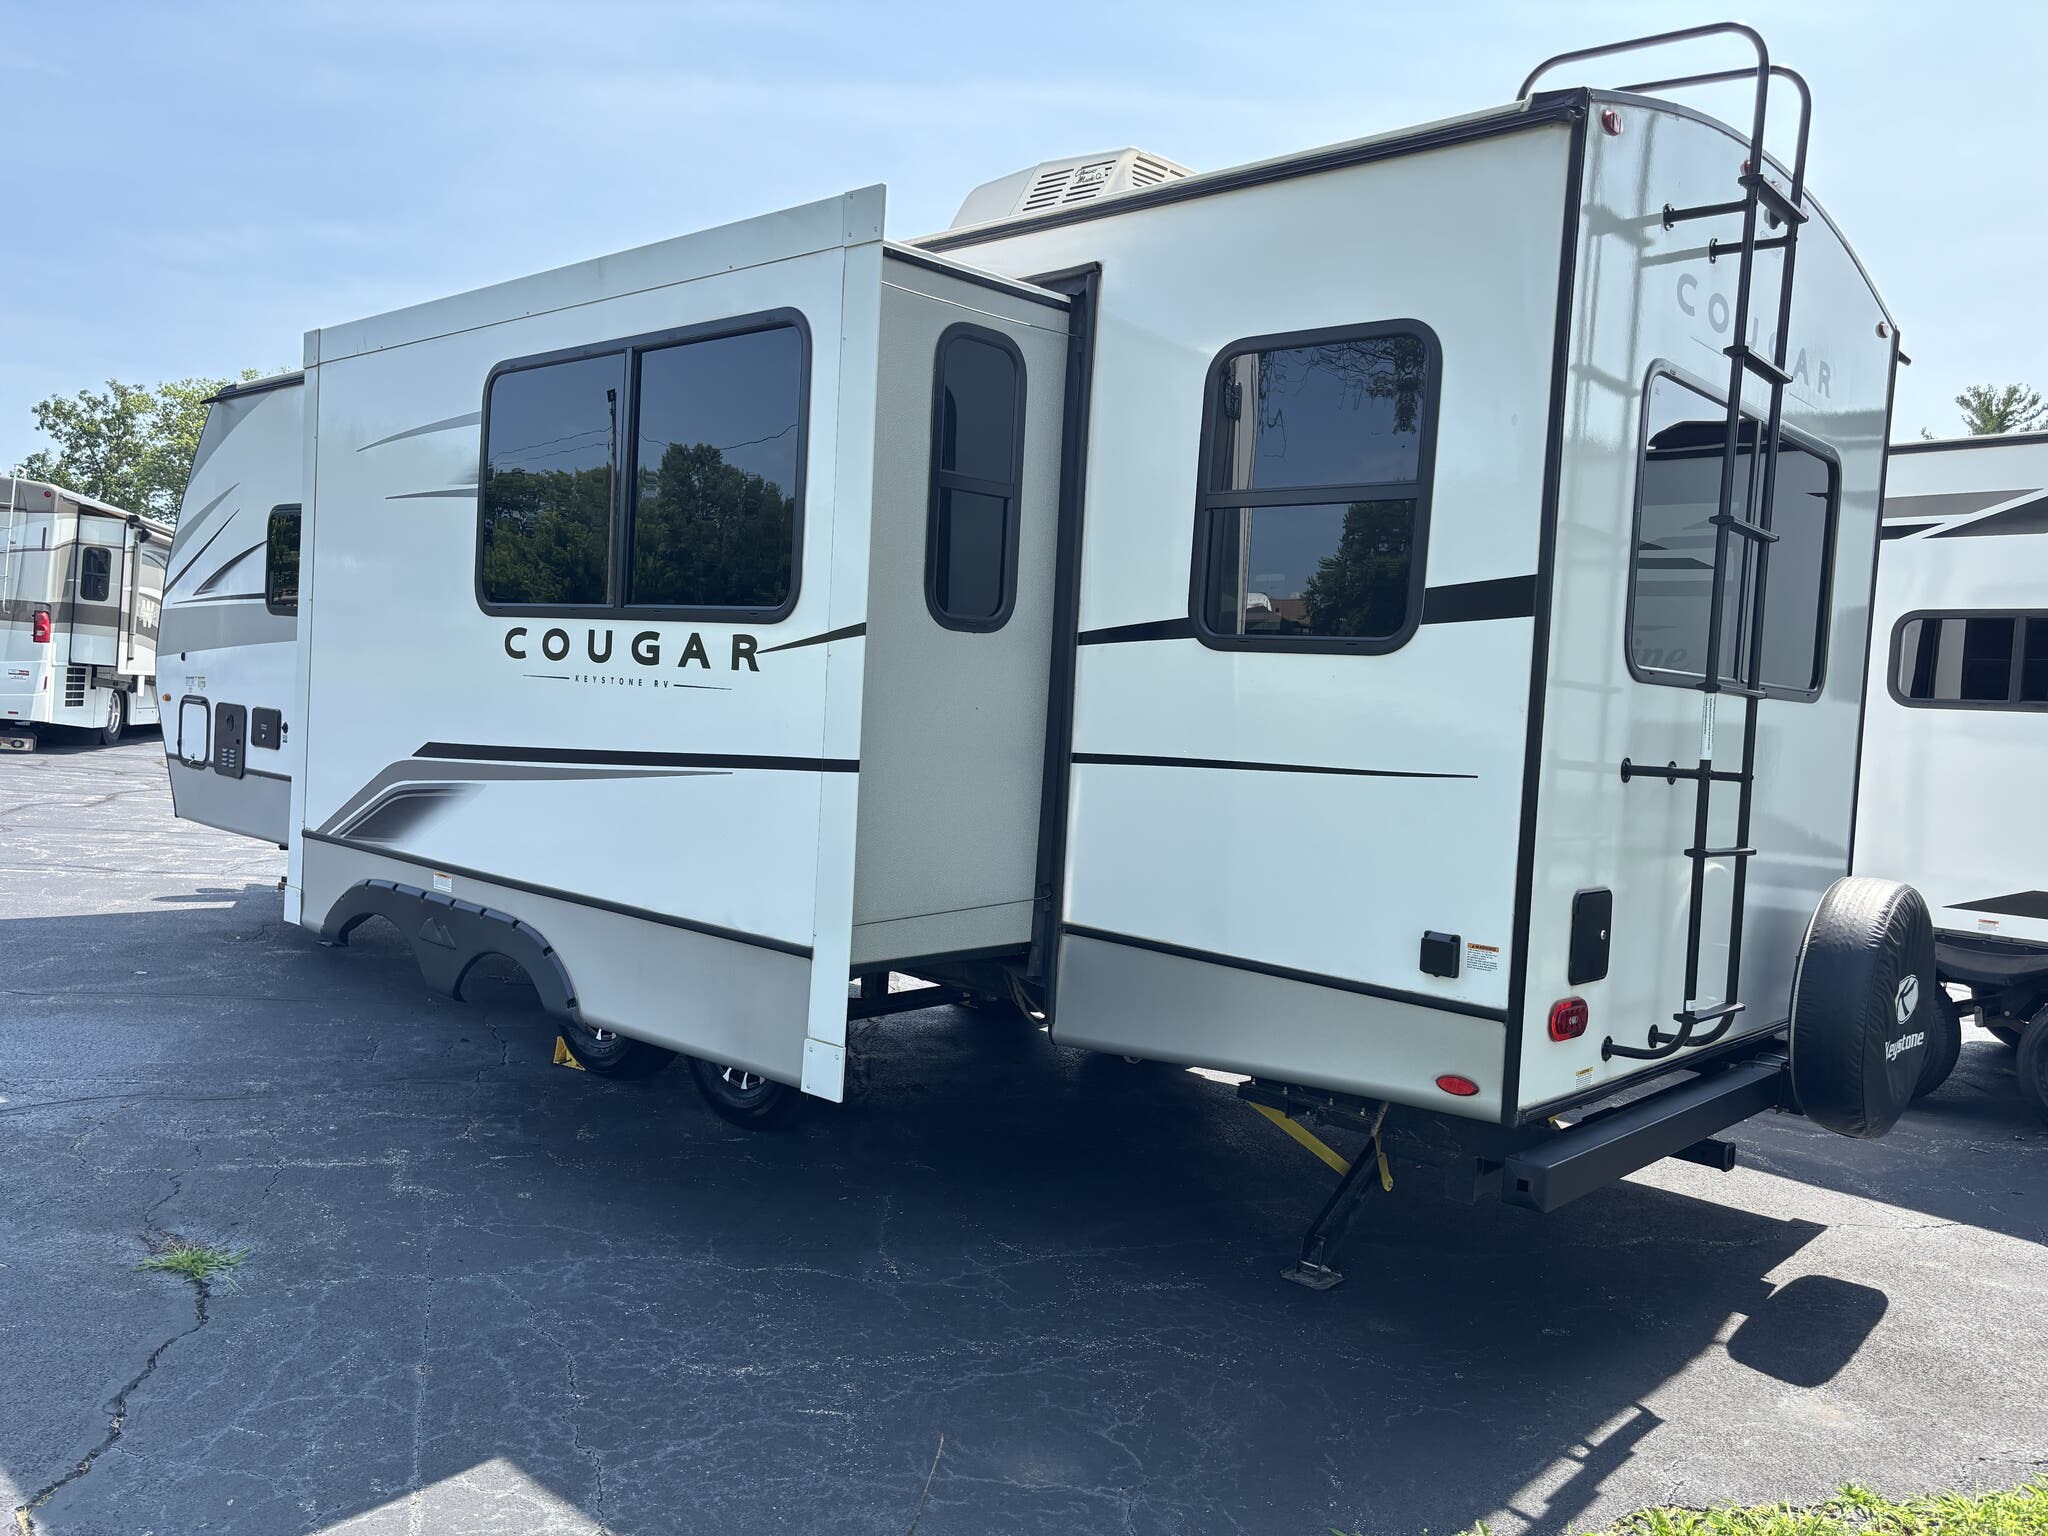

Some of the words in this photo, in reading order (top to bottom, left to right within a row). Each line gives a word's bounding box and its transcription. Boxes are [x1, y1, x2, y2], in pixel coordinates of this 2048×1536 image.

[504, 627, 760, 672] COUGAR
[575, 674, 643, 687] KEYSTONE
[653, 679, 669, 688] RV
